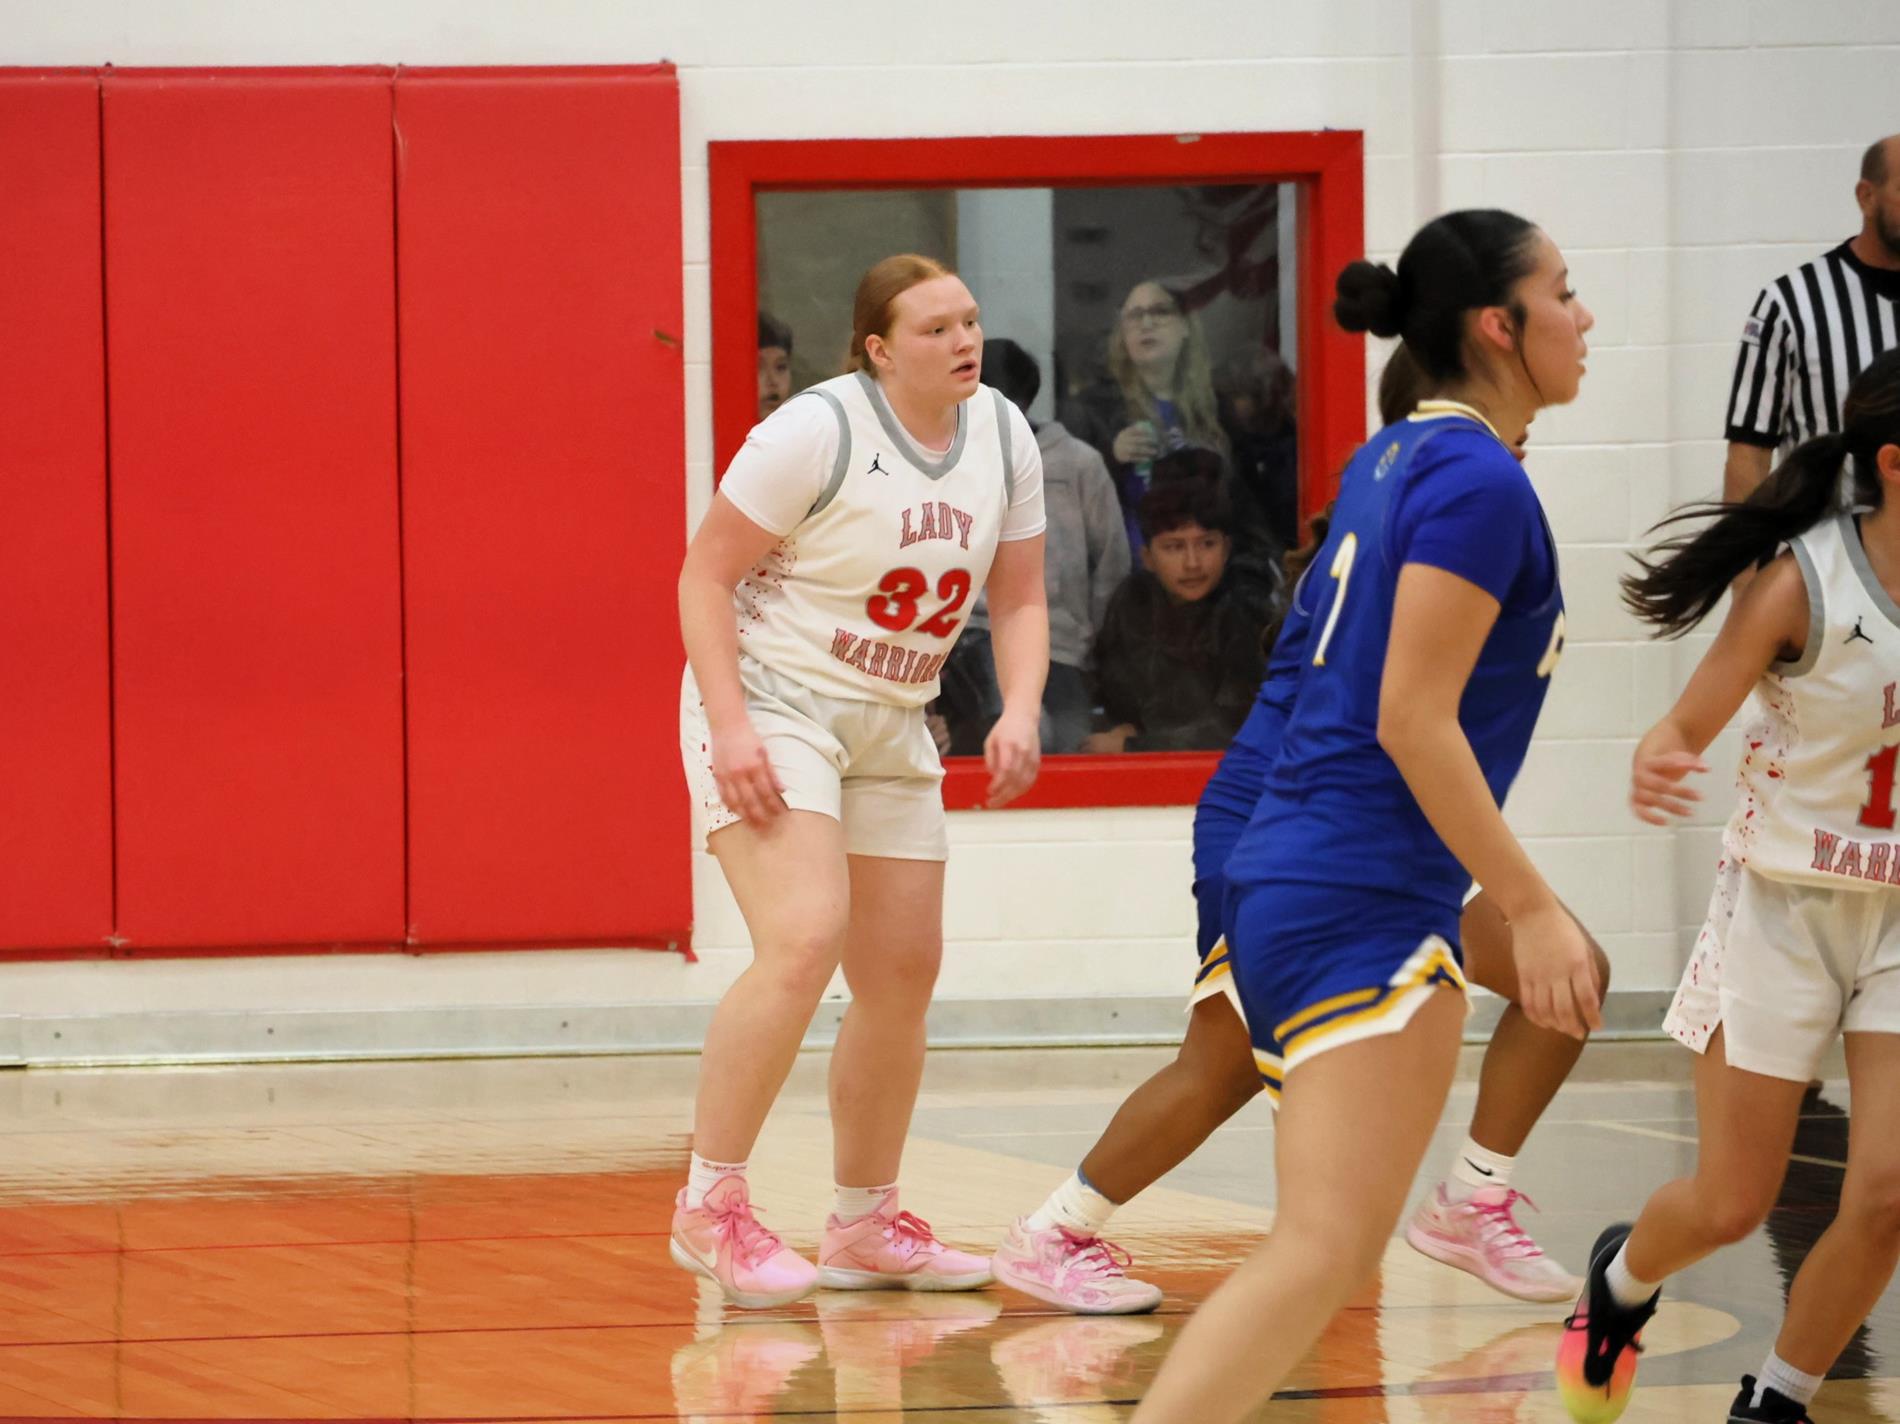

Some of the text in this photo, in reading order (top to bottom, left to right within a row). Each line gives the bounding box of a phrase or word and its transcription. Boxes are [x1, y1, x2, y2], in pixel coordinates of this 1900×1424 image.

[900, 502, 973, 550] LADY
[866, 566, 971, 638] 32
[830, 628, 948, 683] WARRIOR
